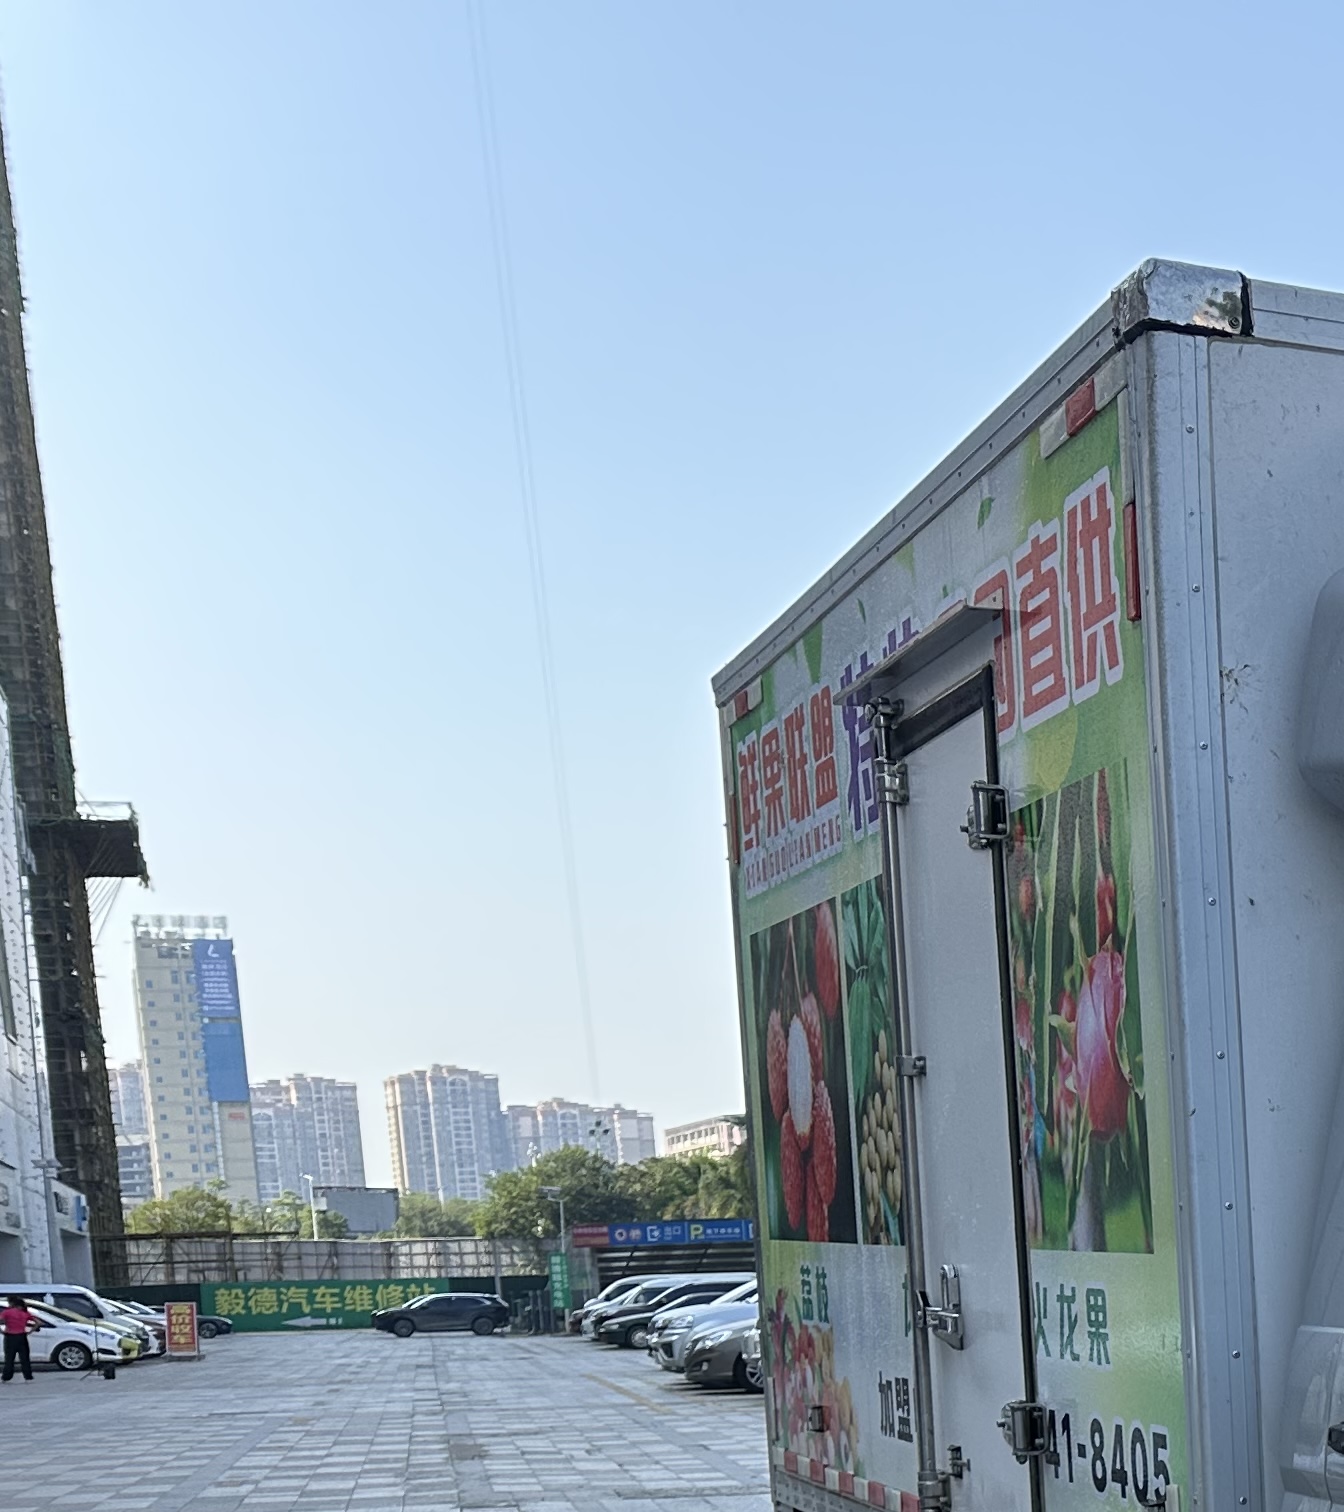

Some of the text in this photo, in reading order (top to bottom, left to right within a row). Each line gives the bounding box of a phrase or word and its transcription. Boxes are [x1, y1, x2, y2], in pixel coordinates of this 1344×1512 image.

[738, 685, 838, 851] 鲜果联盟
[800, 1265, 830, 1324] 荔枝
[1034, 1281, 1111, 1365] 火龙果
